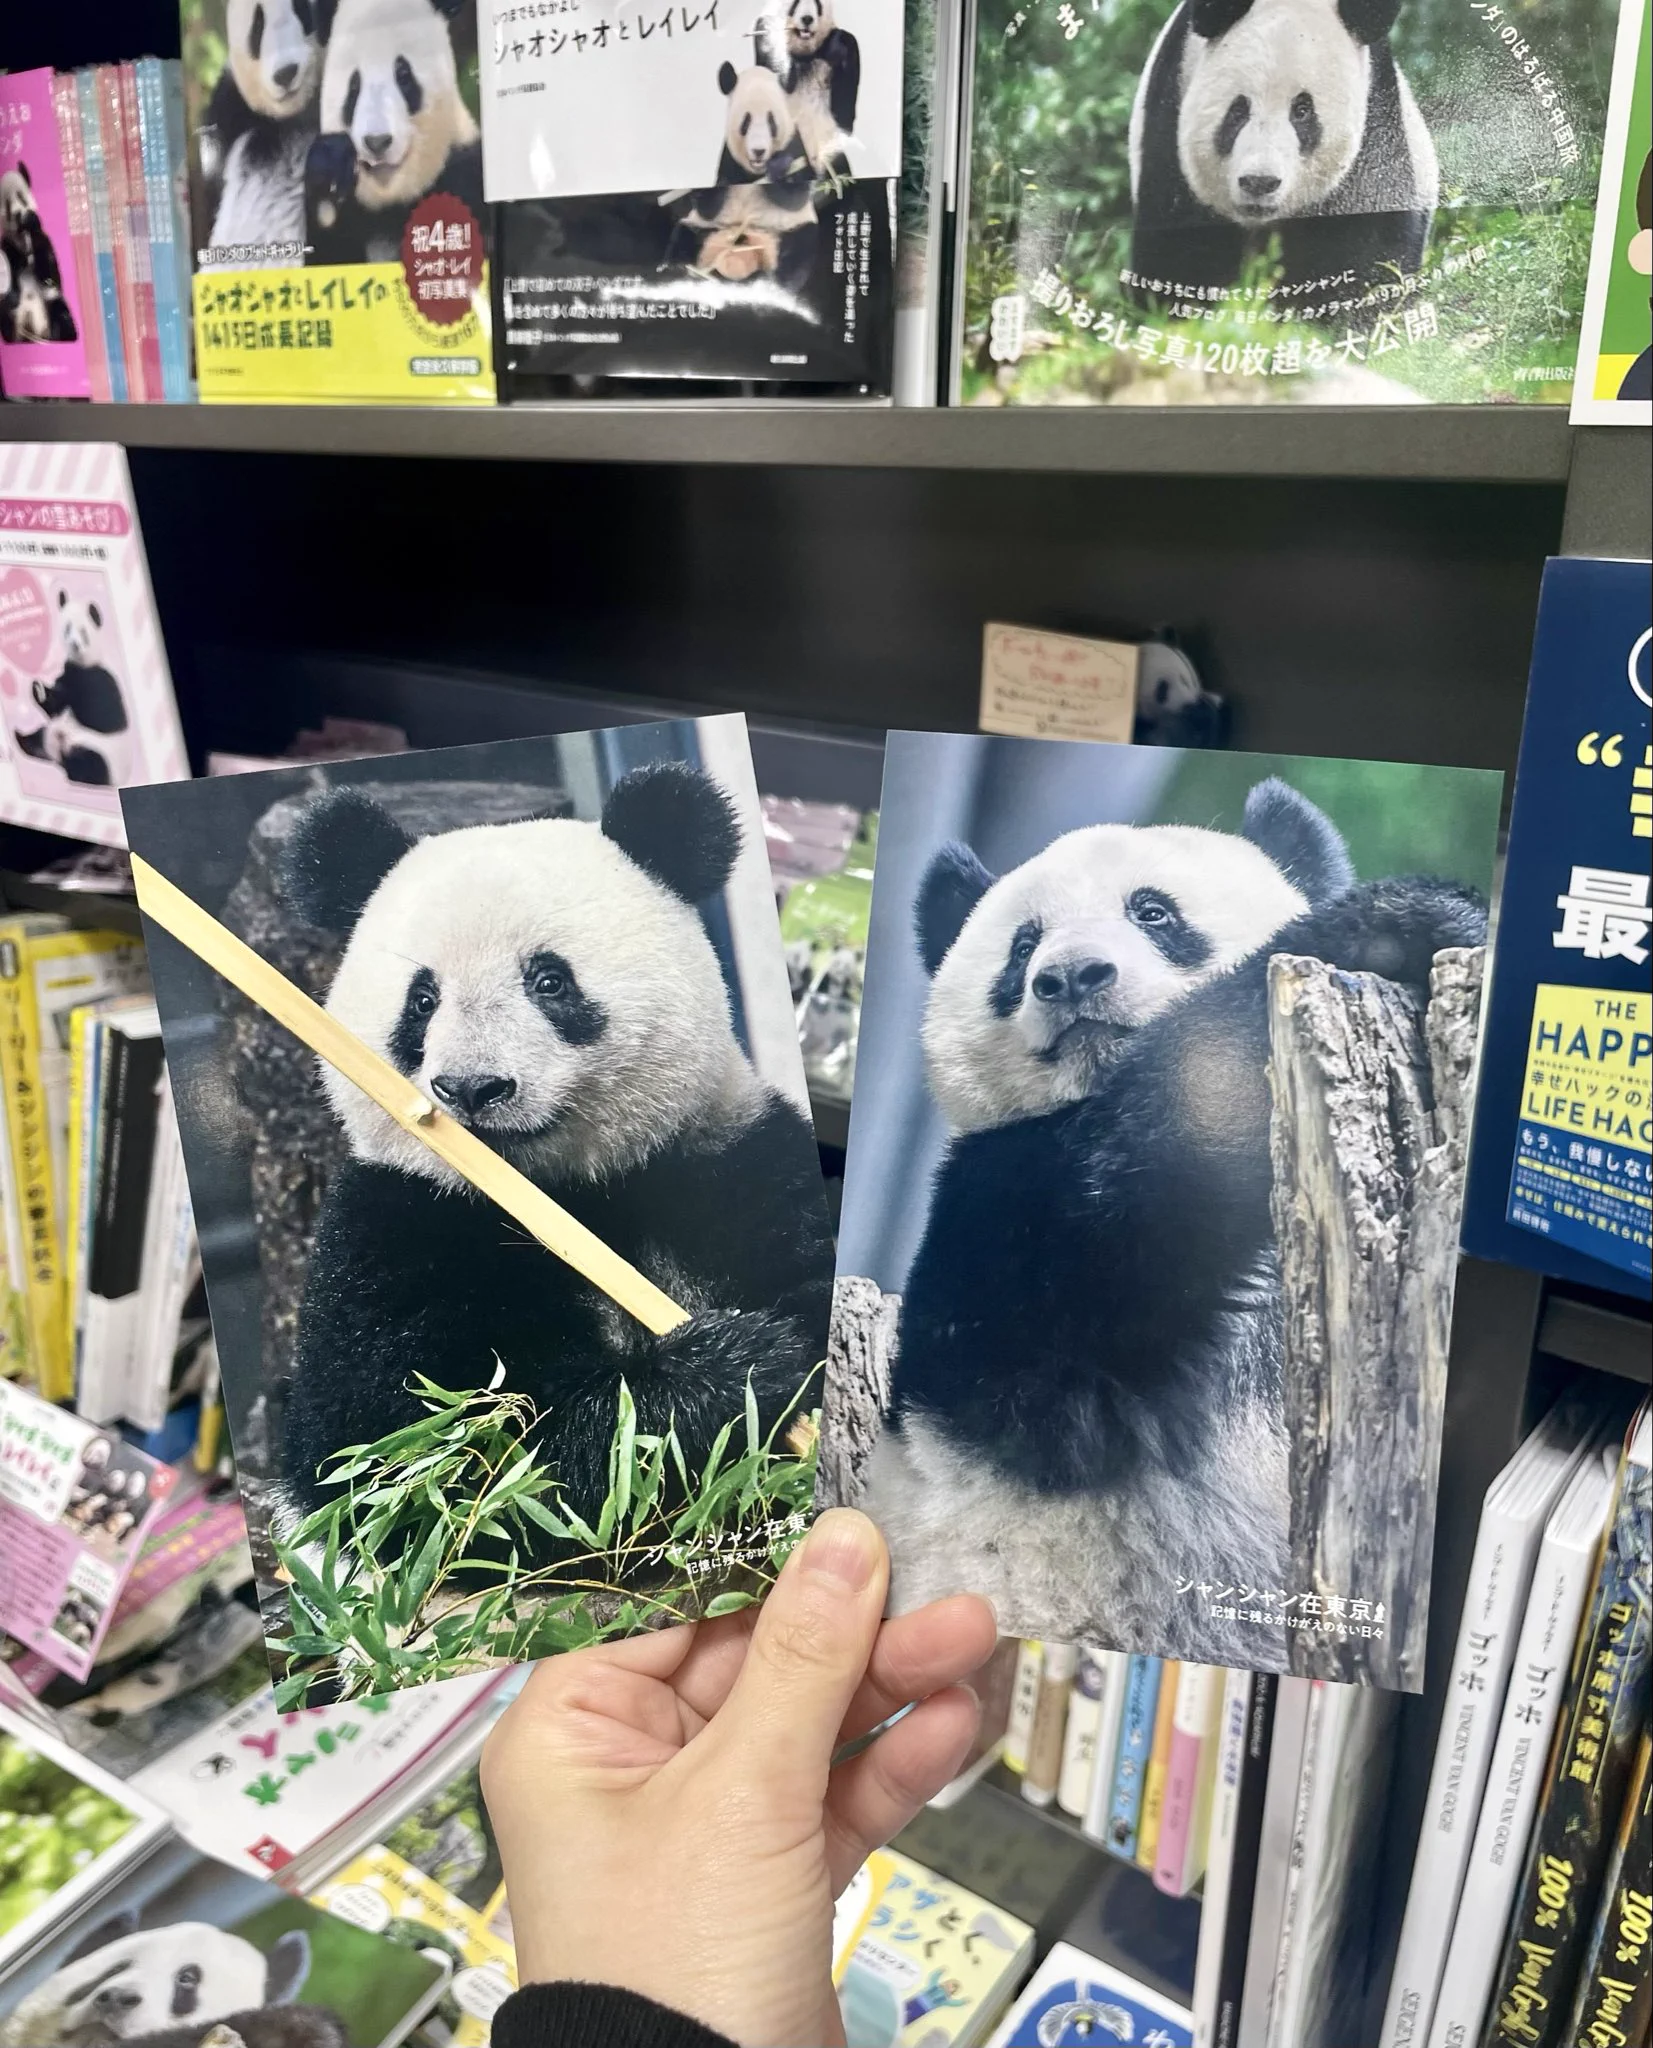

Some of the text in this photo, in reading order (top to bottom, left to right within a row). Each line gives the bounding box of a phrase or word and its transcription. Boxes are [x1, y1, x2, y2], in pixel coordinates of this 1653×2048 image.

[495, 0, 719, 64] シャオシャオとレイレイ
[1029, 267, 1439, 376] 撮りおろし写真120枚超を大公開
[1553, 865, 1651, 965] 最
[1595, 1000, 1637, 1021] THE
[1528, 1091, 1586, 1126] LIFE
[1531, 1070, 1652, 1111] 幸せハックの
[649, 1511, 814, 1566] シャンシャン在東
[1175, 1575, 1373, 1621] シャンシャン在東京
[1211, 1604, 1385, 1640] 記憶に残るかけがえのない日々
[1458, 1630, 1498, 1692] ゴッホ
[1515, 1663, 1557, 1726] ゴッホ
[1438, 1704, 1476, 1833] VINCENT VAN GOGH
[1490, 1738, 1532, 1867] VINCENT VAN GOGH
[1534, 1853, 1573, 1929] 100%
[1615, 1888, 1653, 1965] 100%
